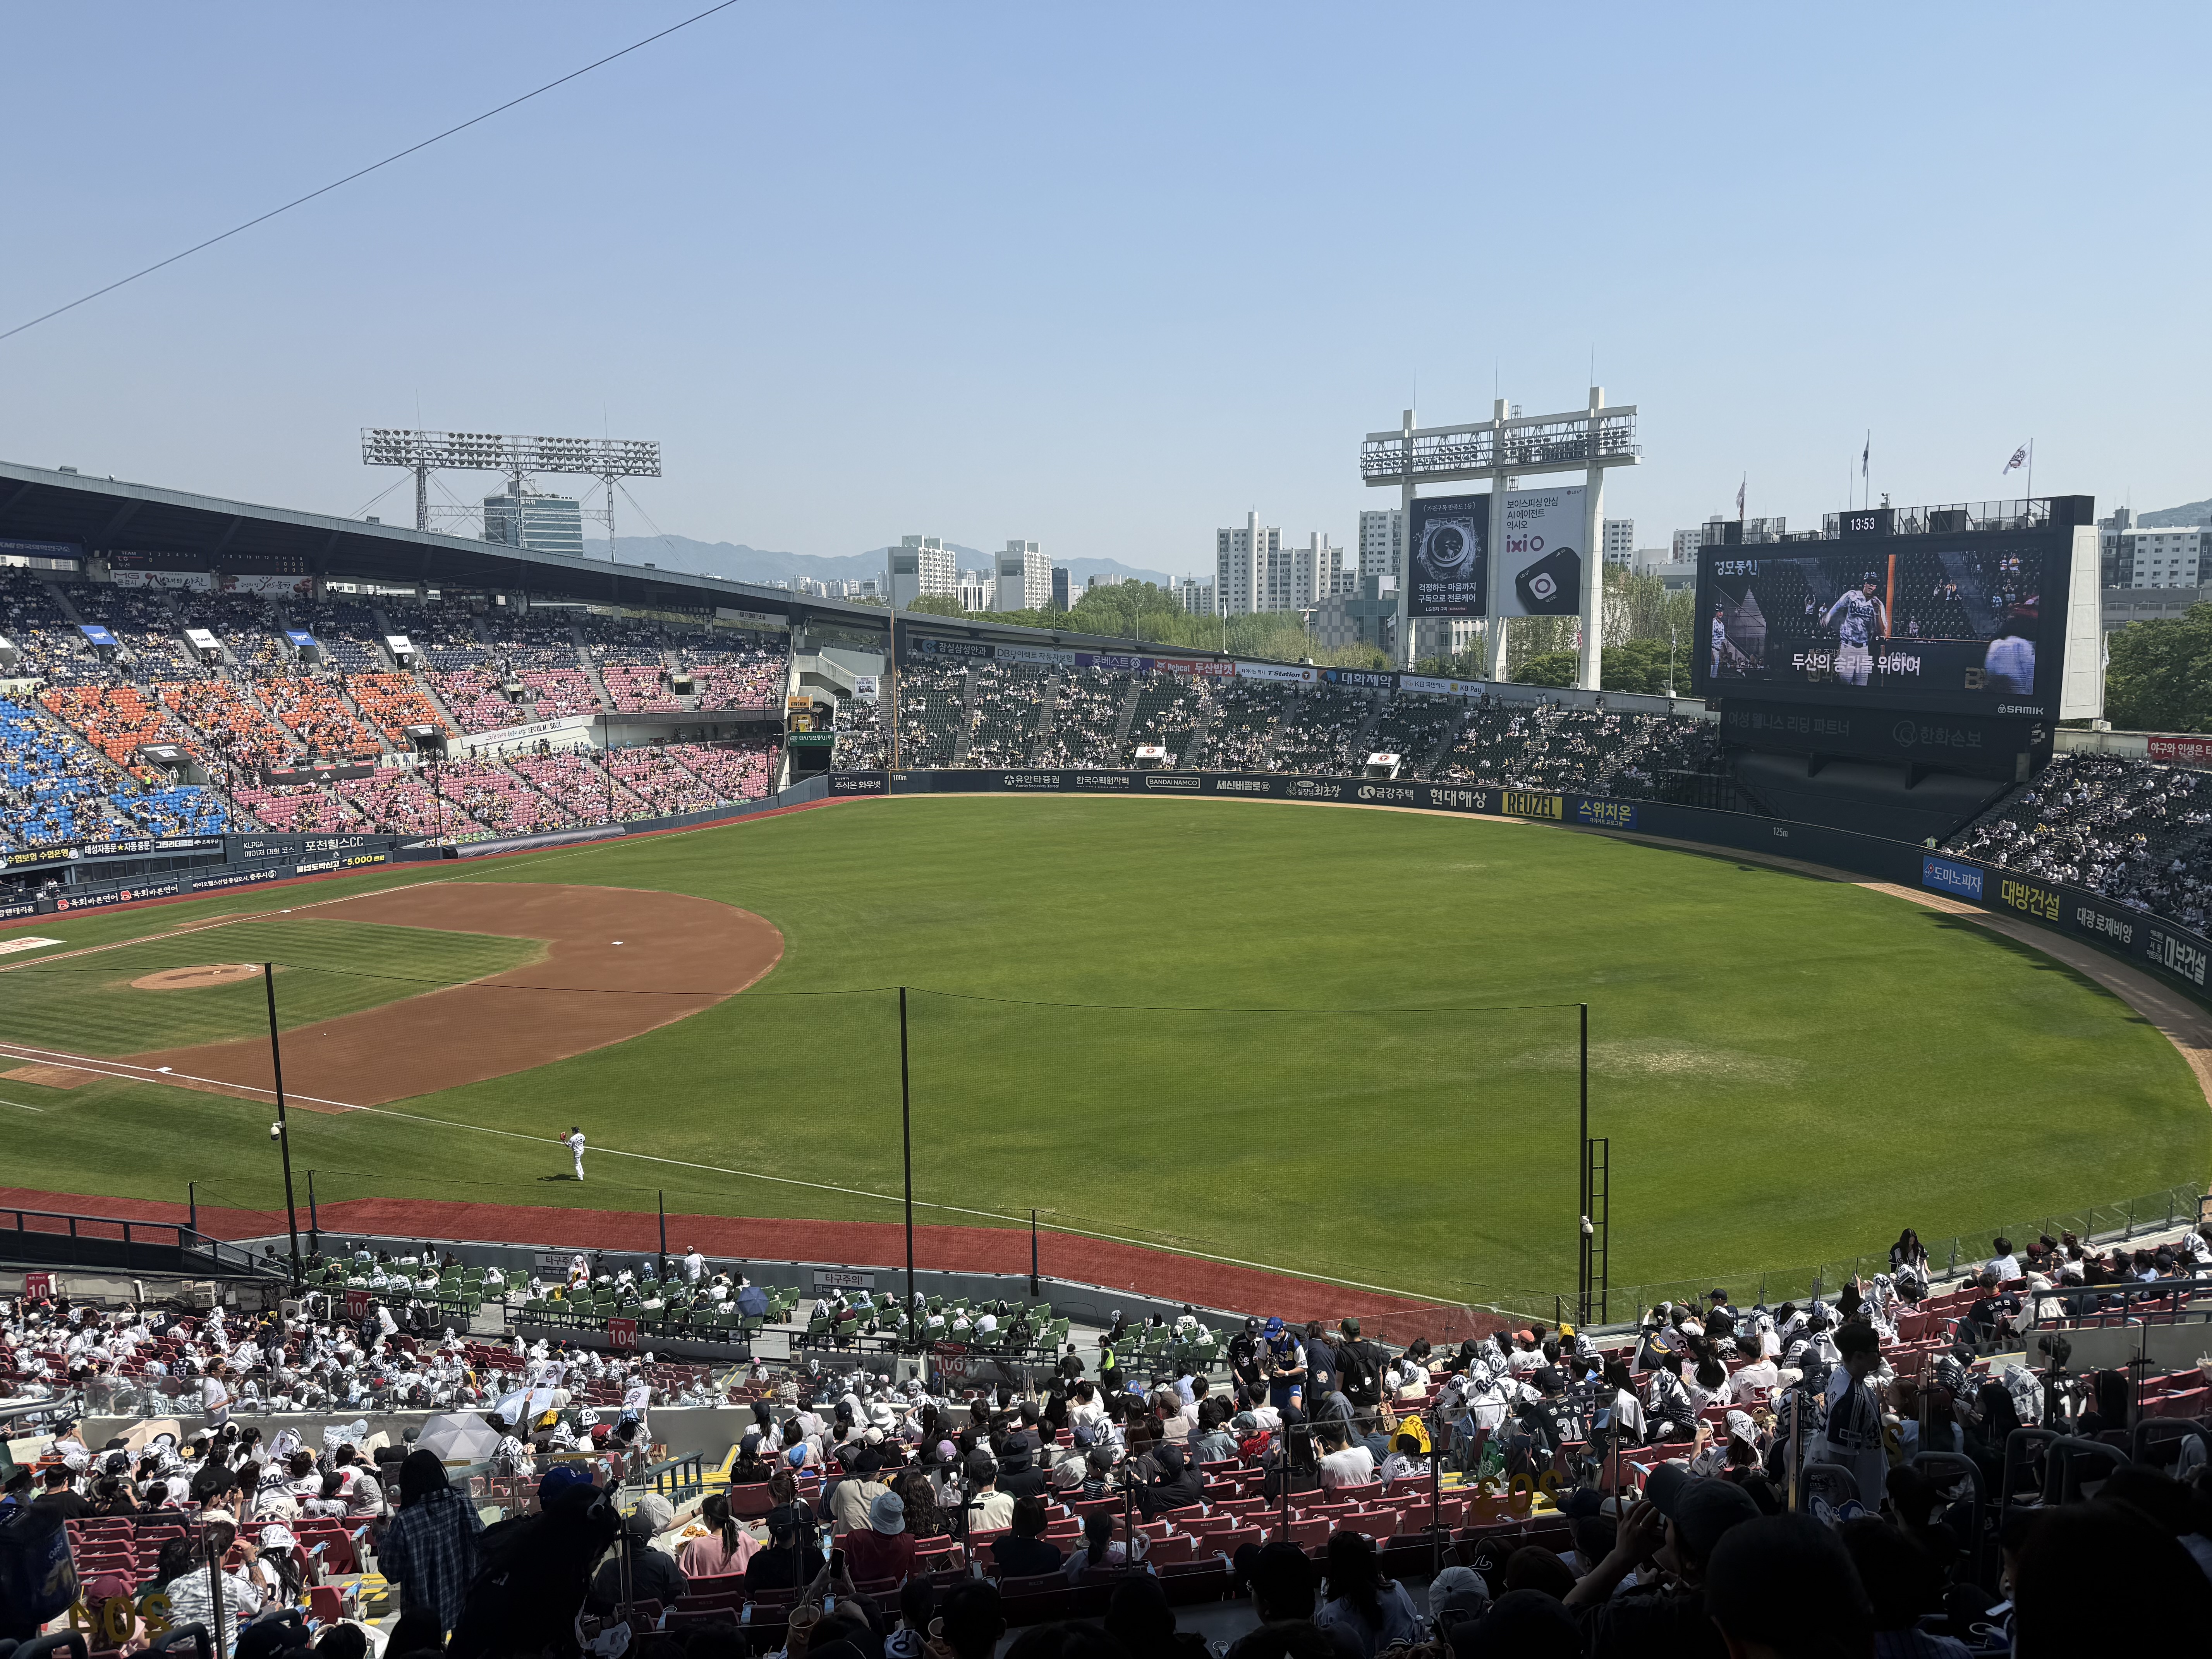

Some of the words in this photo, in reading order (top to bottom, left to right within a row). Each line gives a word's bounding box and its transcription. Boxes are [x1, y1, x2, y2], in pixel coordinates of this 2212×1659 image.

[1507, 498, 1542, 508] 보이스피싱
[1544, 496, 1558, 507] 안심
[1507, 511, 1515, 519] AI
[1516, 509, 1545, 519] 에이전트
[1507, 520, 1528, 530] 익시오
[1850, 517, 1875, 531] 13:53
[1419, 583, 1446, 592] 걱정하는
[1448, 582, 1476, 591] 마음까지
[1418, 594, 1446, 603] 구독으로
[1448, 593, 1476, 603] 전문케어
[939, 642, 986, 656] 잠실삼성안과
[1092, 655, 1129, 667] 몽베스트
[1792, 654, 1830, 672] 두산의
[1833, 655, 1874, 674] 승리를
[1877, 656, 1920, 676] 위하여
[1195, 663, 1232, 675] 두산밥캣
[1341, 672, 1393, 687] 대화제약
[1470, 686, 1482, 695] Pay
[2007, 705, 2044, 714] SAMIK
[1729, 711, 1749, 728] 여성
[1752, 713, 1784, 730] 웰니스
[1787, 715, 1810, 733] 리딩
[1813, 717, 1849, 737] 파트너
[1920, 726, 1982, 747] 한화손보
[2150, 742, 2176, 755] 야구와
[2178, 744, 2203, 756] 인생은
[835, 781, 857, 789] 주식은
[859, 781, 881, 789] 와우넷
[1015, 775, 1060, 784] 유안타증권
[1076, 776, 1129, 785] 한국수력원자력
[1217, 780, 1261, 791] 세신버팔로
[1297, 788, 1314, 797] 실장님
[1376, 787, 1414, 800] 금강주택
[1430, 788, 1487, 809] 현대해상
[1508, 793, 1556, 817] REUZEL
[1580, 801, 1632, 822] 스위치온
[1773, 827, 1788, 838] 125m
[85, 843, 117, 855] 태성자동문
[244, 841, 264, 849] KLPGA
[282, 846, 295, 854] 코스
[305, 836, 364, 852] 포천힐스CC
[7, 852, 37, 864] 수협보험
[347, 855, 373, 866] 5,000
[250, 871, 268, 881] 충주시
[1933, 866, 1982, 893] 도미노피자
[2001, 879, 2060, 922] 대방건설
[2077, 907, 2095, 929] 대광
[2095, 914, 2133, 944] 로제비앙
[2164, 936, 2206, 986] 대보건설
[545, 1255, 574, 1267] 타구주
[824, 1273, 863, 1286] 타구주의!
[1183, 1322, 1192, 1330] 25
[610, 1329, 636, 1346] 104
[173, 1367, 186, 1376] 63
[1548, 1405, 1581, 1417] 정수빈
[1556, 1417, 1583, 1442] 31
